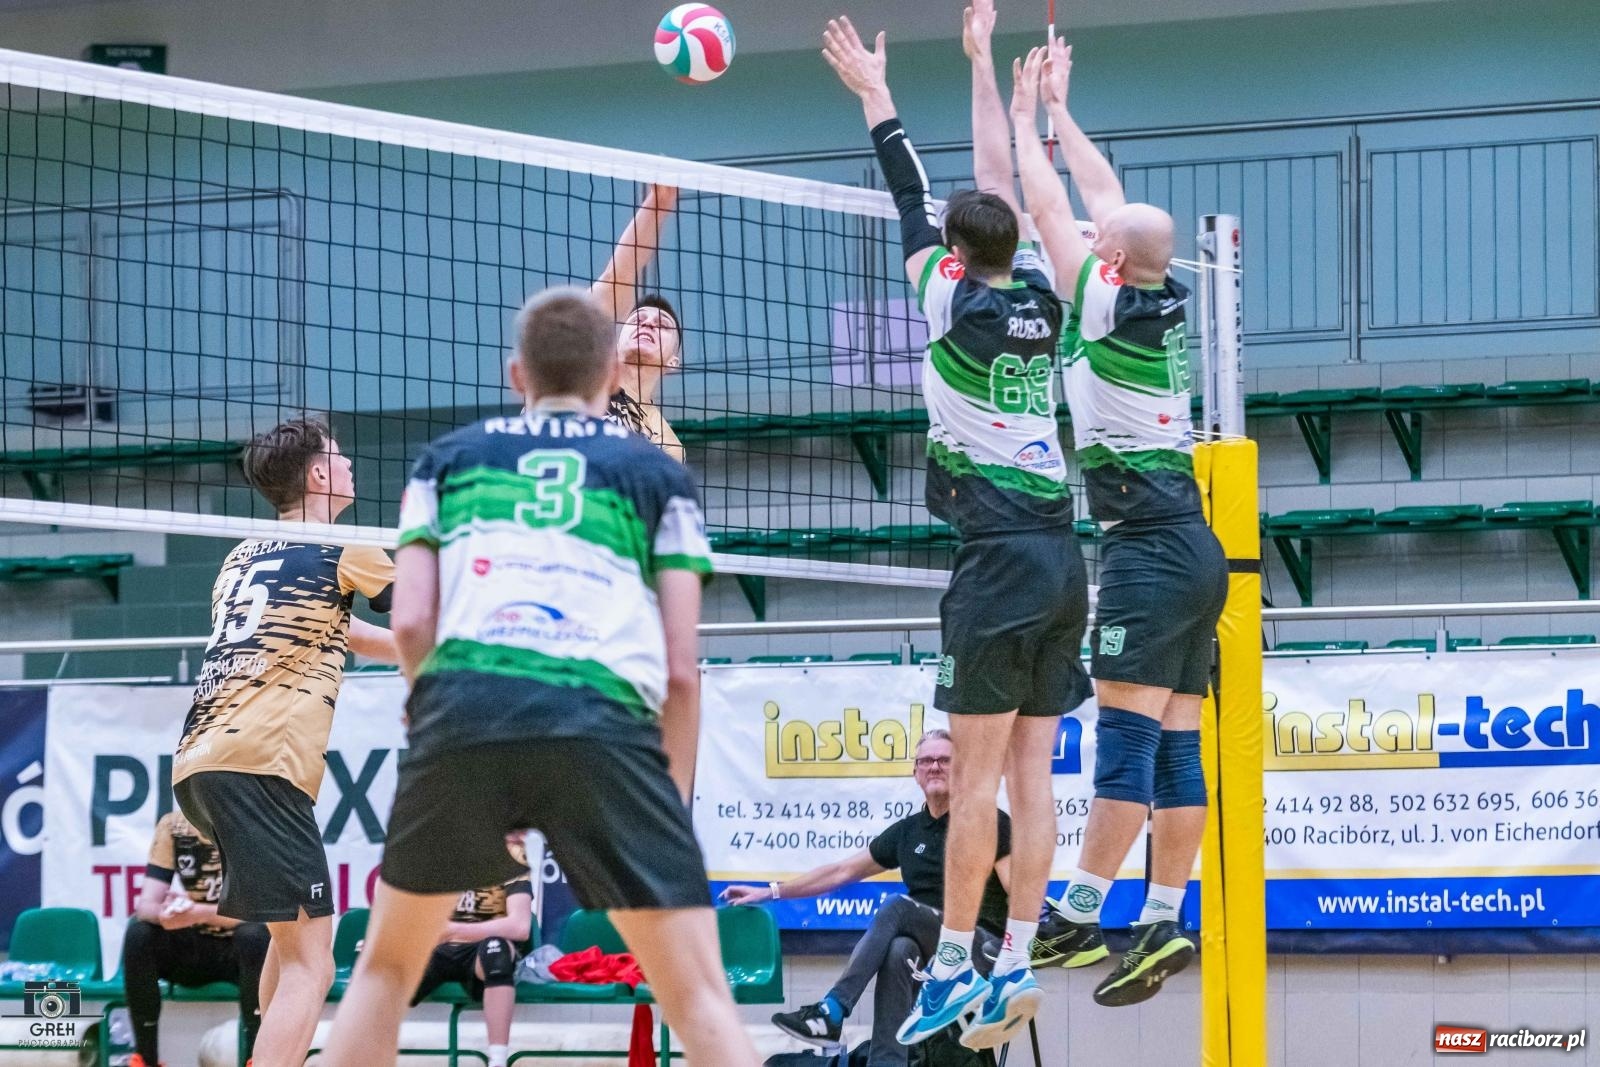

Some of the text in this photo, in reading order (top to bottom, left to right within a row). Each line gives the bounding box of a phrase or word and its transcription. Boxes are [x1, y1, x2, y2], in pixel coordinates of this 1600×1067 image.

[514, 449, 587, 532] 3
[718, 800, 914, 820] tel. 32 414 92 88, 502
[1275, 796, 1314, 815] 414
[1320, 795, 1343, 814] 92
[1349, 794, 1378, 815] 88,
[1390, 794, 1426, 814] 502
[1433, 792, 1470, 812] 632
[1477, 792, 1520, 811] 695,
[1531, 790, 1569, 809] 606
[1574, 788, 1600, 809] 36
[730, 829, 874, 849] 47-400 Racibór
[1303, 824, 1395, 846] Racibórz,
[1401, 823, 1425, 844] ul.
[1431, 824, 1444, 843] J.
[1450, 827, 1488, 842] von
[1317, 887, 1546, 918] www.instal-tech.pl
